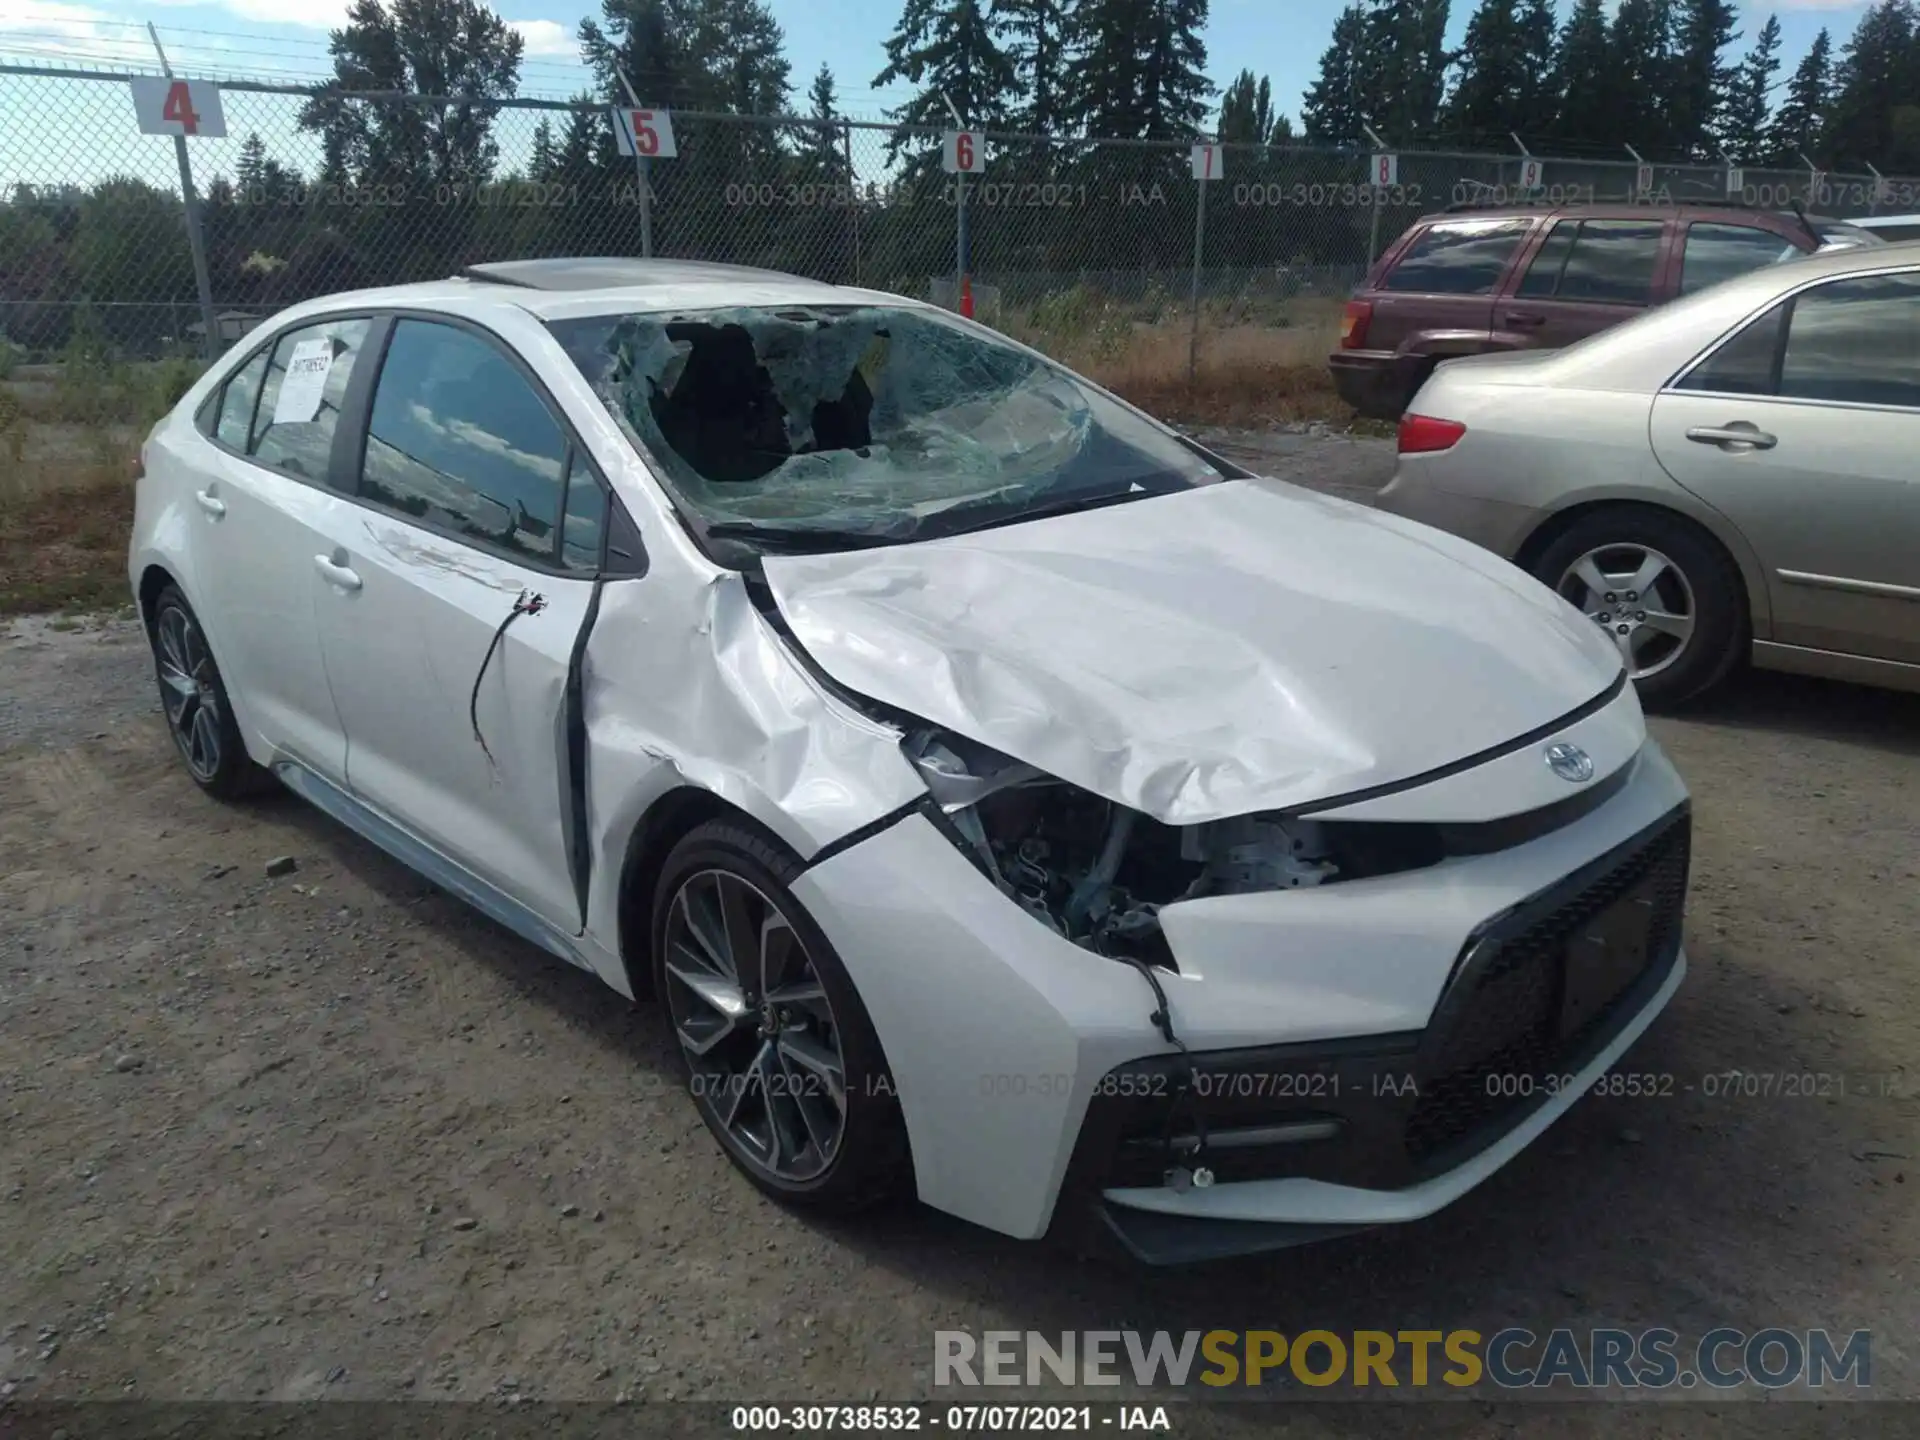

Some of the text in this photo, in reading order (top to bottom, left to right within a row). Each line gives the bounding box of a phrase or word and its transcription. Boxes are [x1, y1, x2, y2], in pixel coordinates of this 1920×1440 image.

[163, 81, 200, 134] 4
[632, 112, 659, 155] 5
[957, 132, 974, 170] 6
[1203, 147, 1212, 177] 7
[1379, 156, 1389, 183] 8
[1526, 163, 1536, 187] 9
